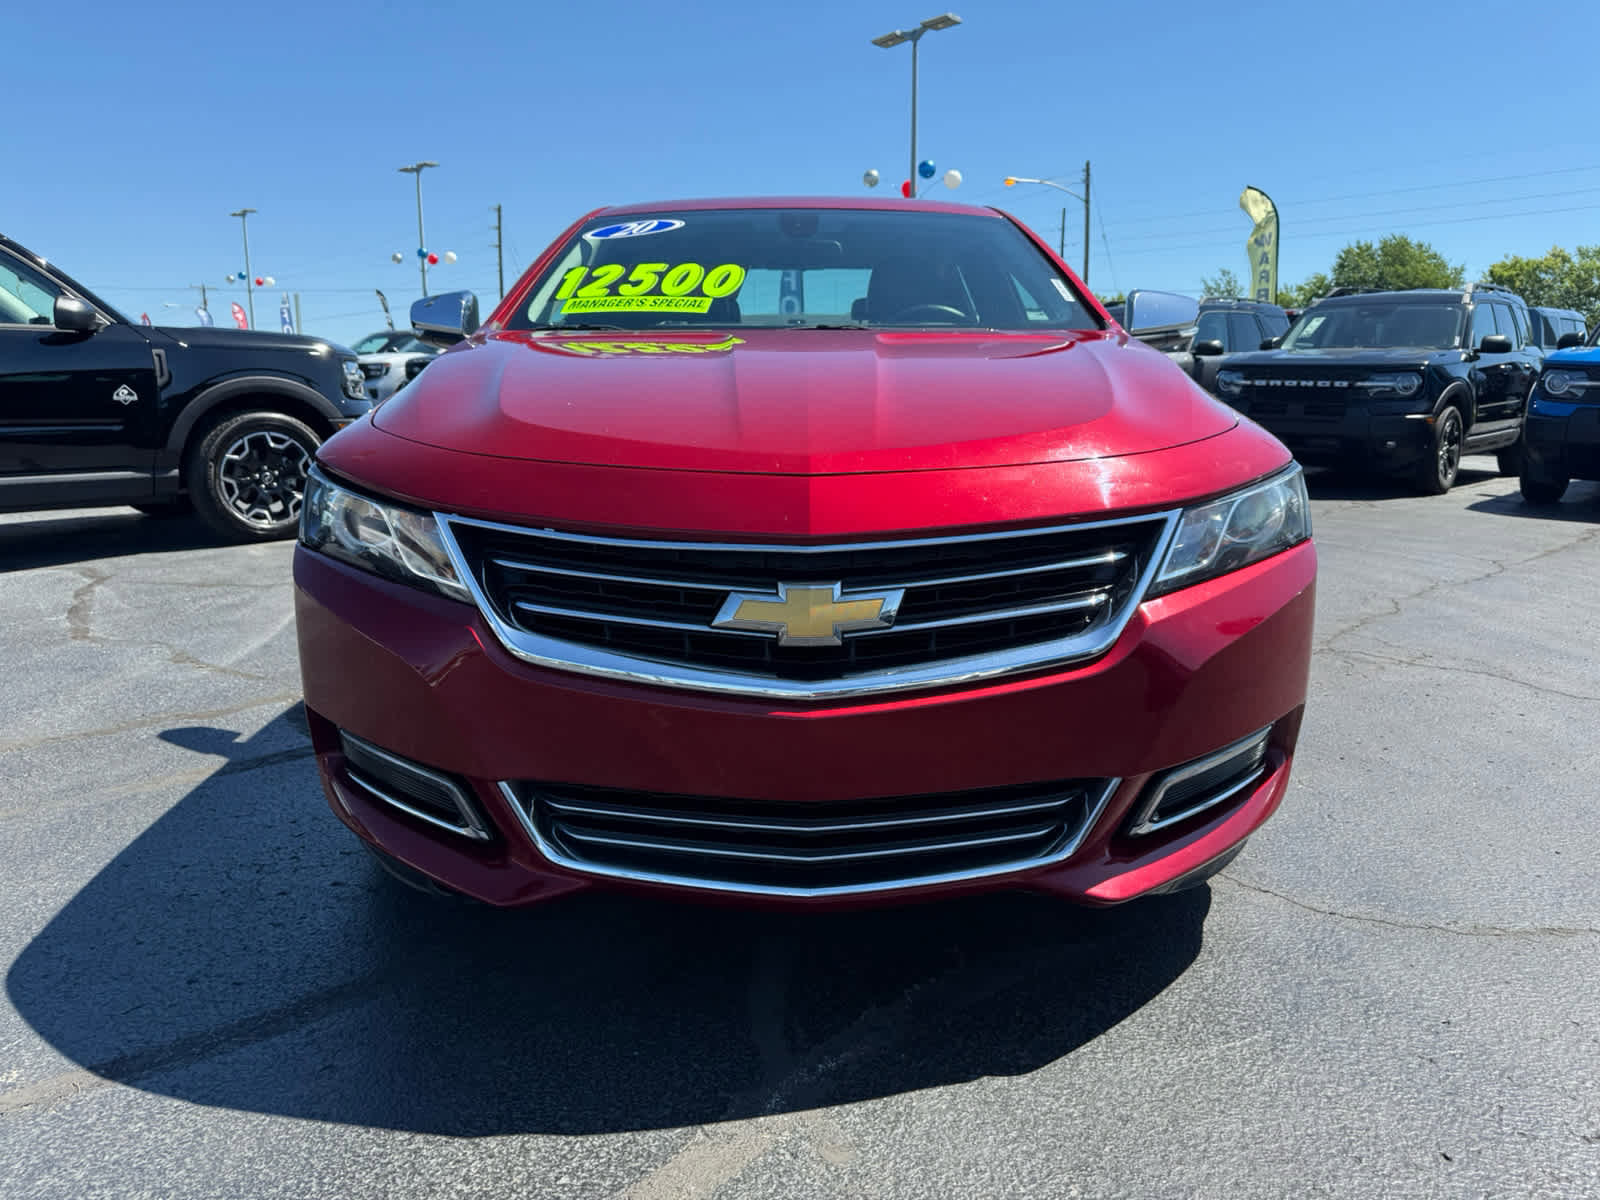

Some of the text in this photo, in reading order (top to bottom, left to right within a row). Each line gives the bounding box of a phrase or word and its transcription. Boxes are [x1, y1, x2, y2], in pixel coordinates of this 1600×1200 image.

[609, 219, 659, 238] 20
[555, 262, 746, 299] 12500
[567, 297, 706, 310] MANAGER'S SPECIAL
[1254, 380, 1349, 388] BRONCO
